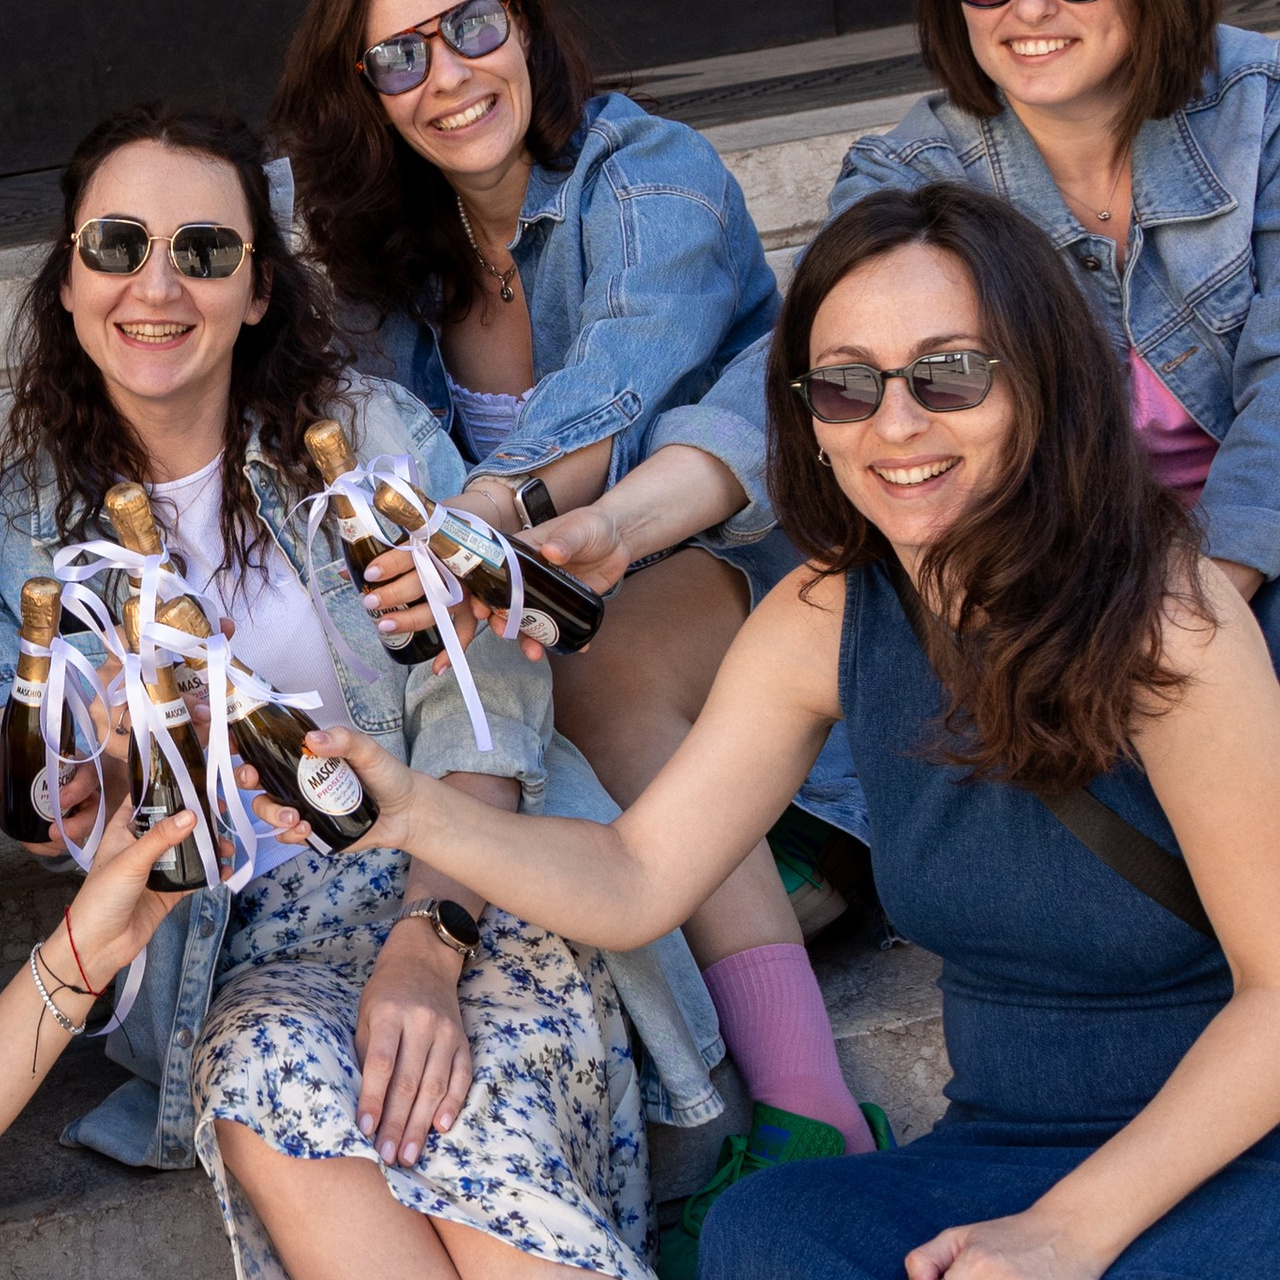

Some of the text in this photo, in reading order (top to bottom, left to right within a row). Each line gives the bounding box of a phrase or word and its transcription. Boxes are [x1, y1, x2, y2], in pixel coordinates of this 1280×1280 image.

[16, 685, 42, 699] MASCHIO
[307, 756, 341, 791] MASCHIO
[316, 764, 349, 800] PROSECCO
